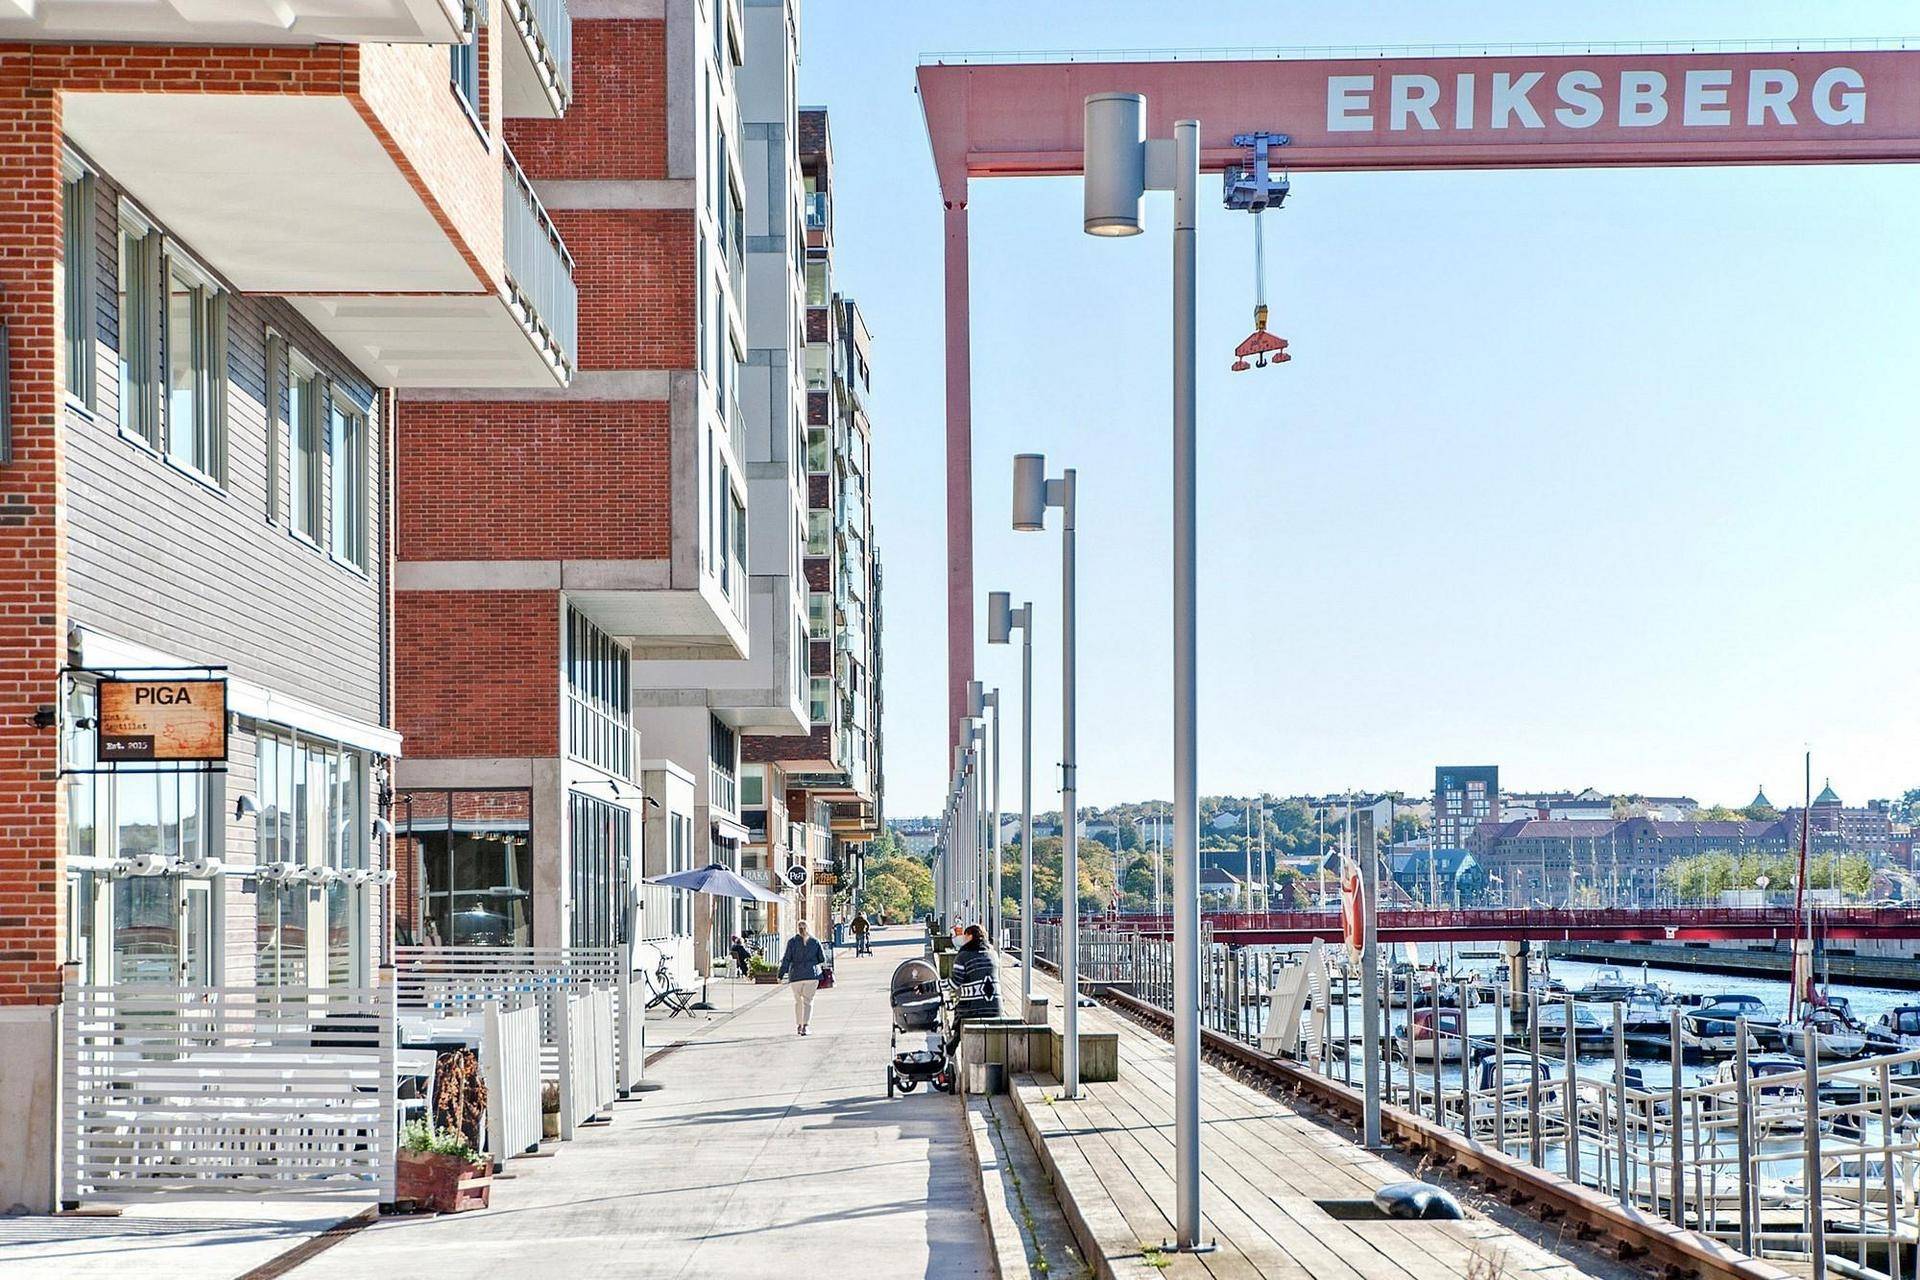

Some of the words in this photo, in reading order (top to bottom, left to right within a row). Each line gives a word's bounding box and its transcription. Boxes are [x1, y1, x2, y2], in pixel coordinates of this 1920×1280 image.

[1327, 67, 1866, 132] ERIKSBERG
[135, 687, 192, 705] PIGA
[106, 742, 125, 750] Est.
[128, 741, 148, 750] 2015
[790, 871, 805, 881] P&T
